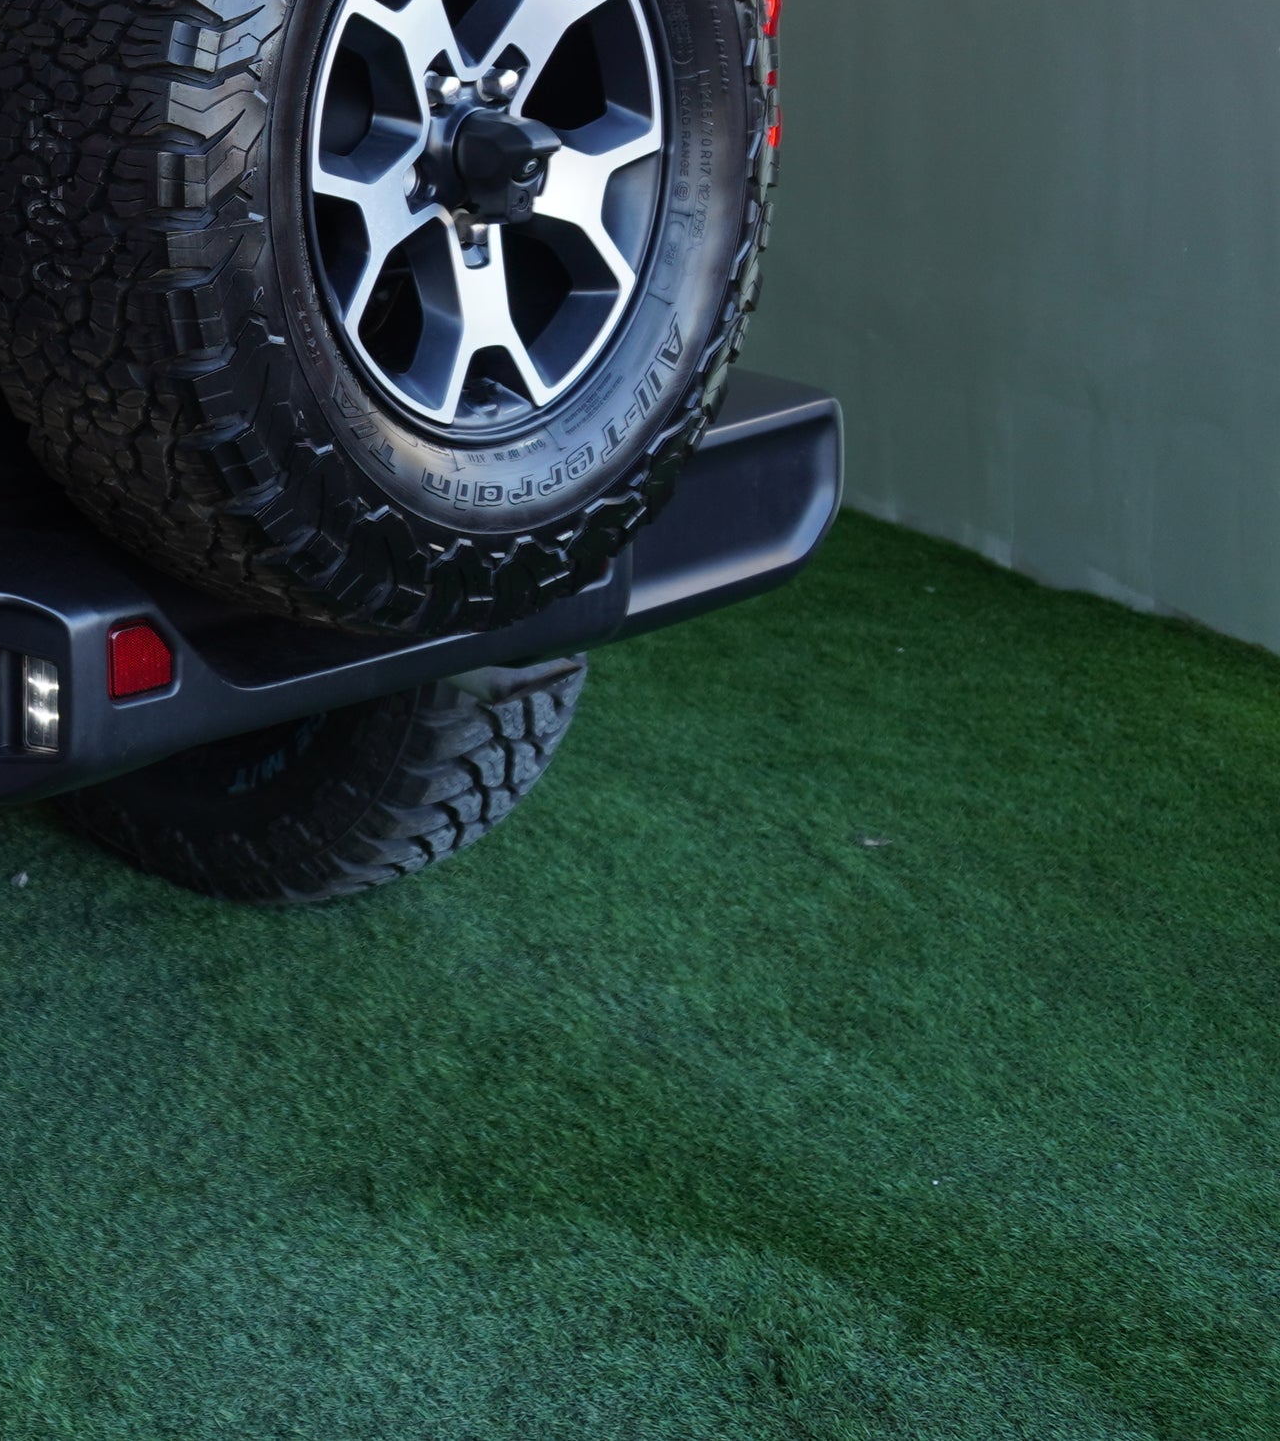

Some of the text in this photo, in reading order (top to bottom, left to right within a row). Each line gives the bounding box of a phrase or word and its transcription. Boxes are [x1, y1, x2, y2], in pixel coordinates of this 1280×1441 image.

[678, 85, 691, 129] LOAD
[679, 130, 691, 177] RANGE
[330, 376, 397, 474] T/A
[421, 312, 687, 511] All-Terrain
